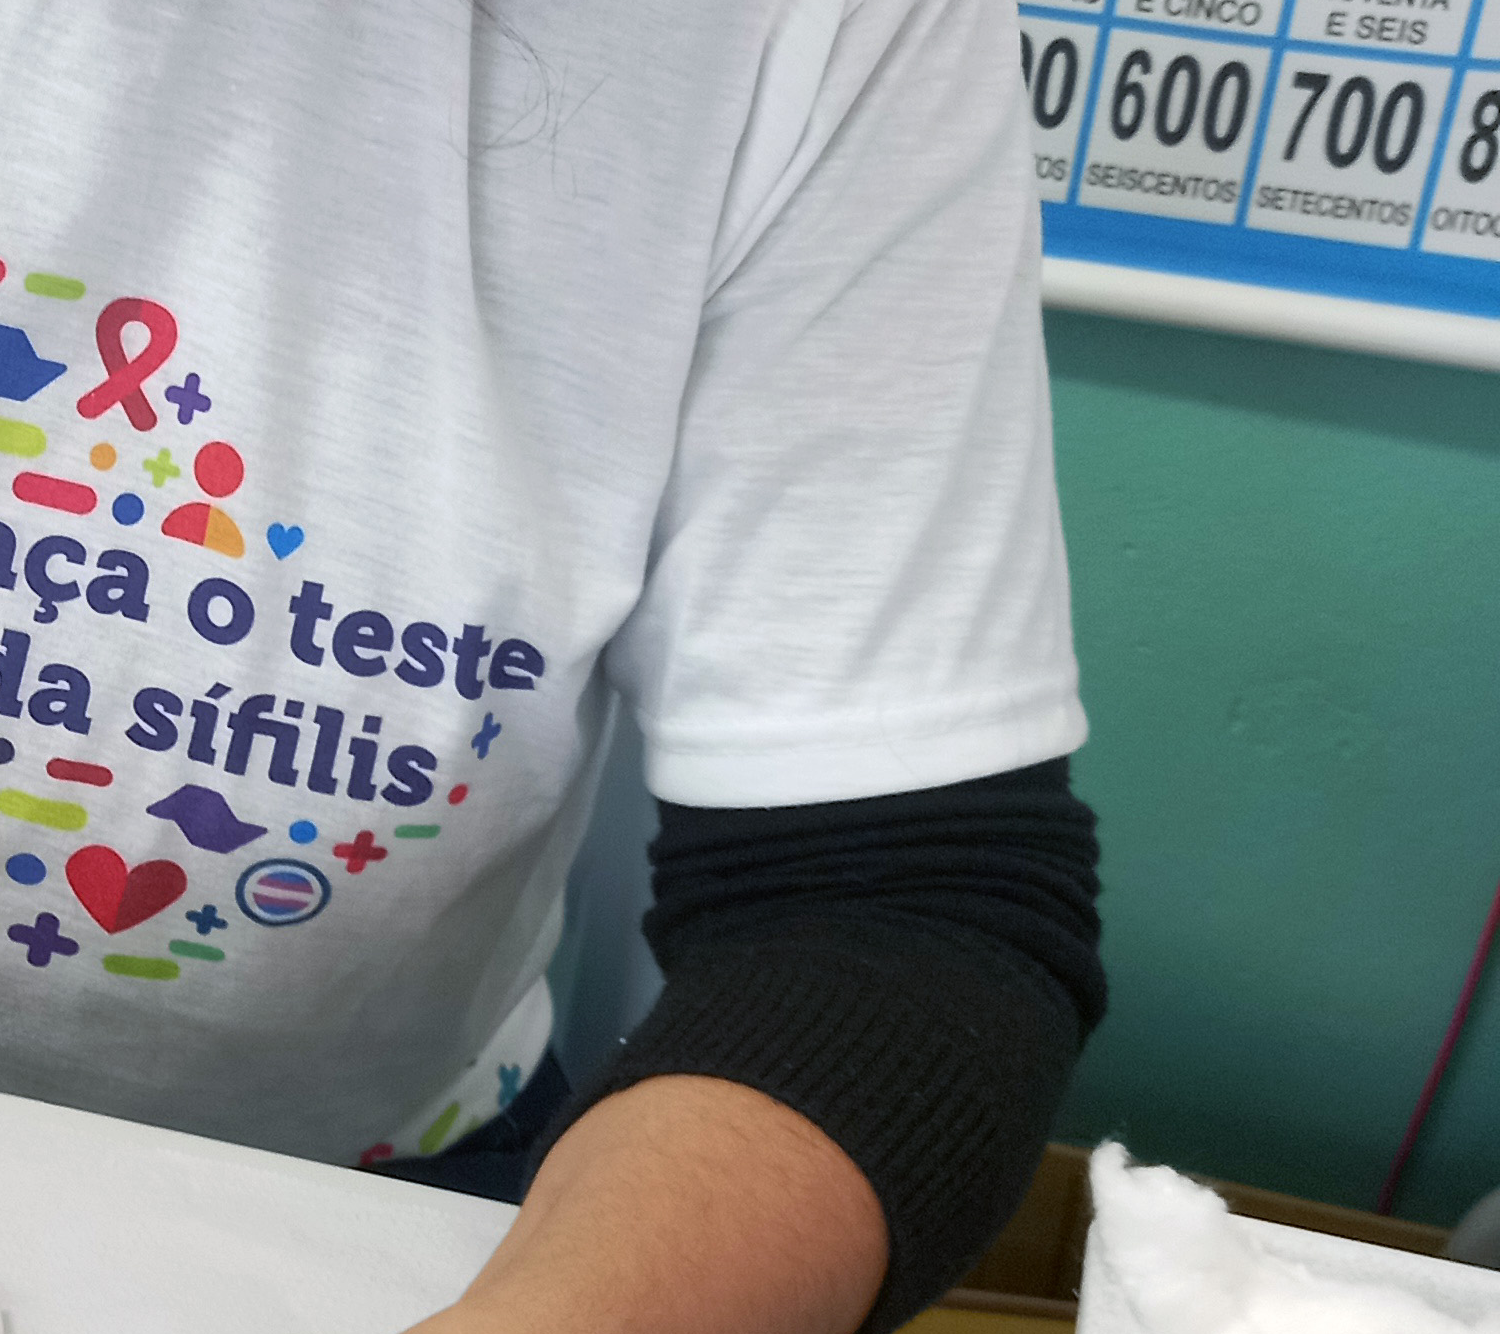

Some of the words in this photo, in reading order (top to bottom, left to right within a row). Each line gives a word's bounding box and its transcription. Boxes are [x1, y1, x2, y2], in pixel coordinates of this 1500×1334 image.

[1325, 11, 1349, 37] E
[1356, 15, 1429, 46] SEIS
[1110, 48, 1252, 153] 600
[1283, 71, 1425, 175] 700
[1087, 163, 1238, 205] SEISCENTOS
[1256, 183, 1413, 227] SETECENTOS
[187, 577, 255, 646] o
[288, 580, 546, 701] teste
[124, 682, 438, 807] sífilis
